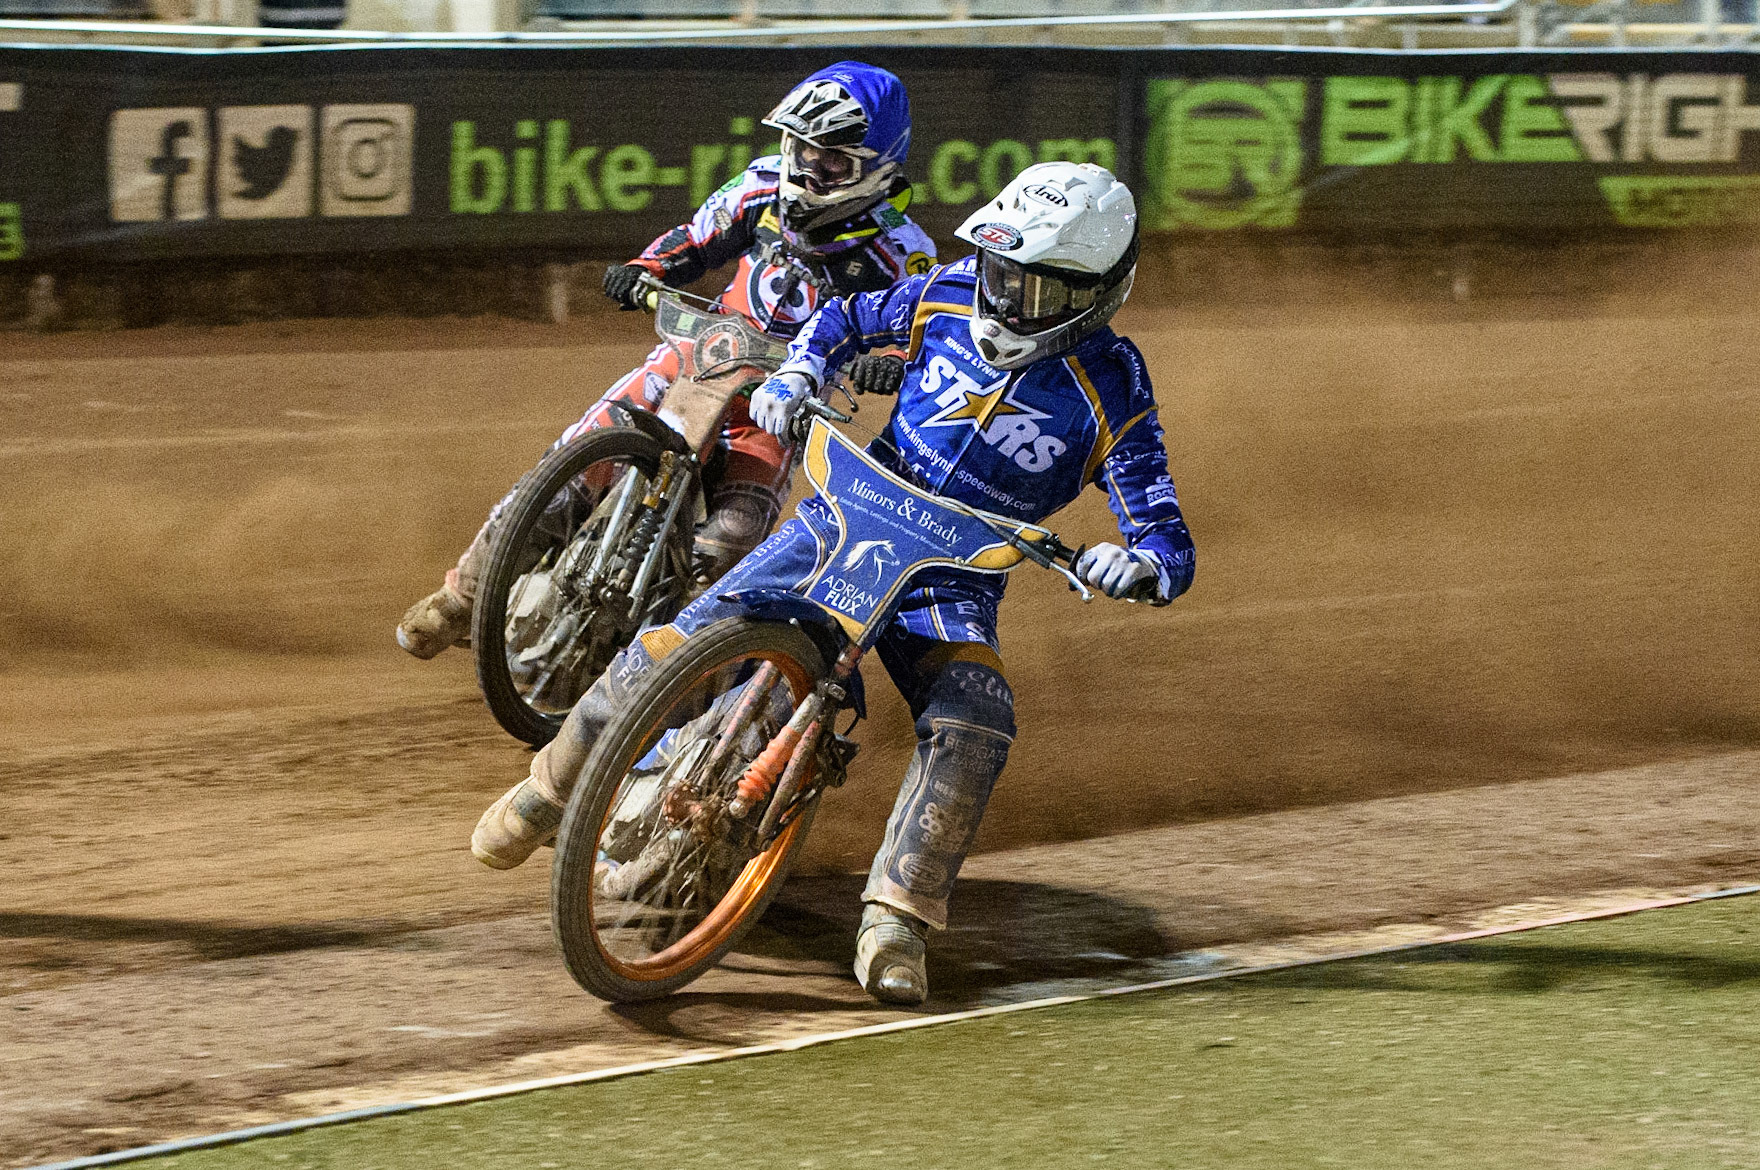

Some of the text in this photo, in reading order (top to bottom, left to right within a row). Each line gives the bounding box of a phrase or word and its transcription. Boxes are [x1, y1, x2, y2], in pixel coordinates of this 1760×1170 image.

[451, 115, 1117, 213] bike-ri.com
[978, 227, 1015, 244] STS
[944, 336, 1000, 379] KING'S LYNN
[847, 478, 962, 546] Minors & Brady
[821, 575, 879, 609] ADRIAN
[824, 589, 861, 616] FLUX
